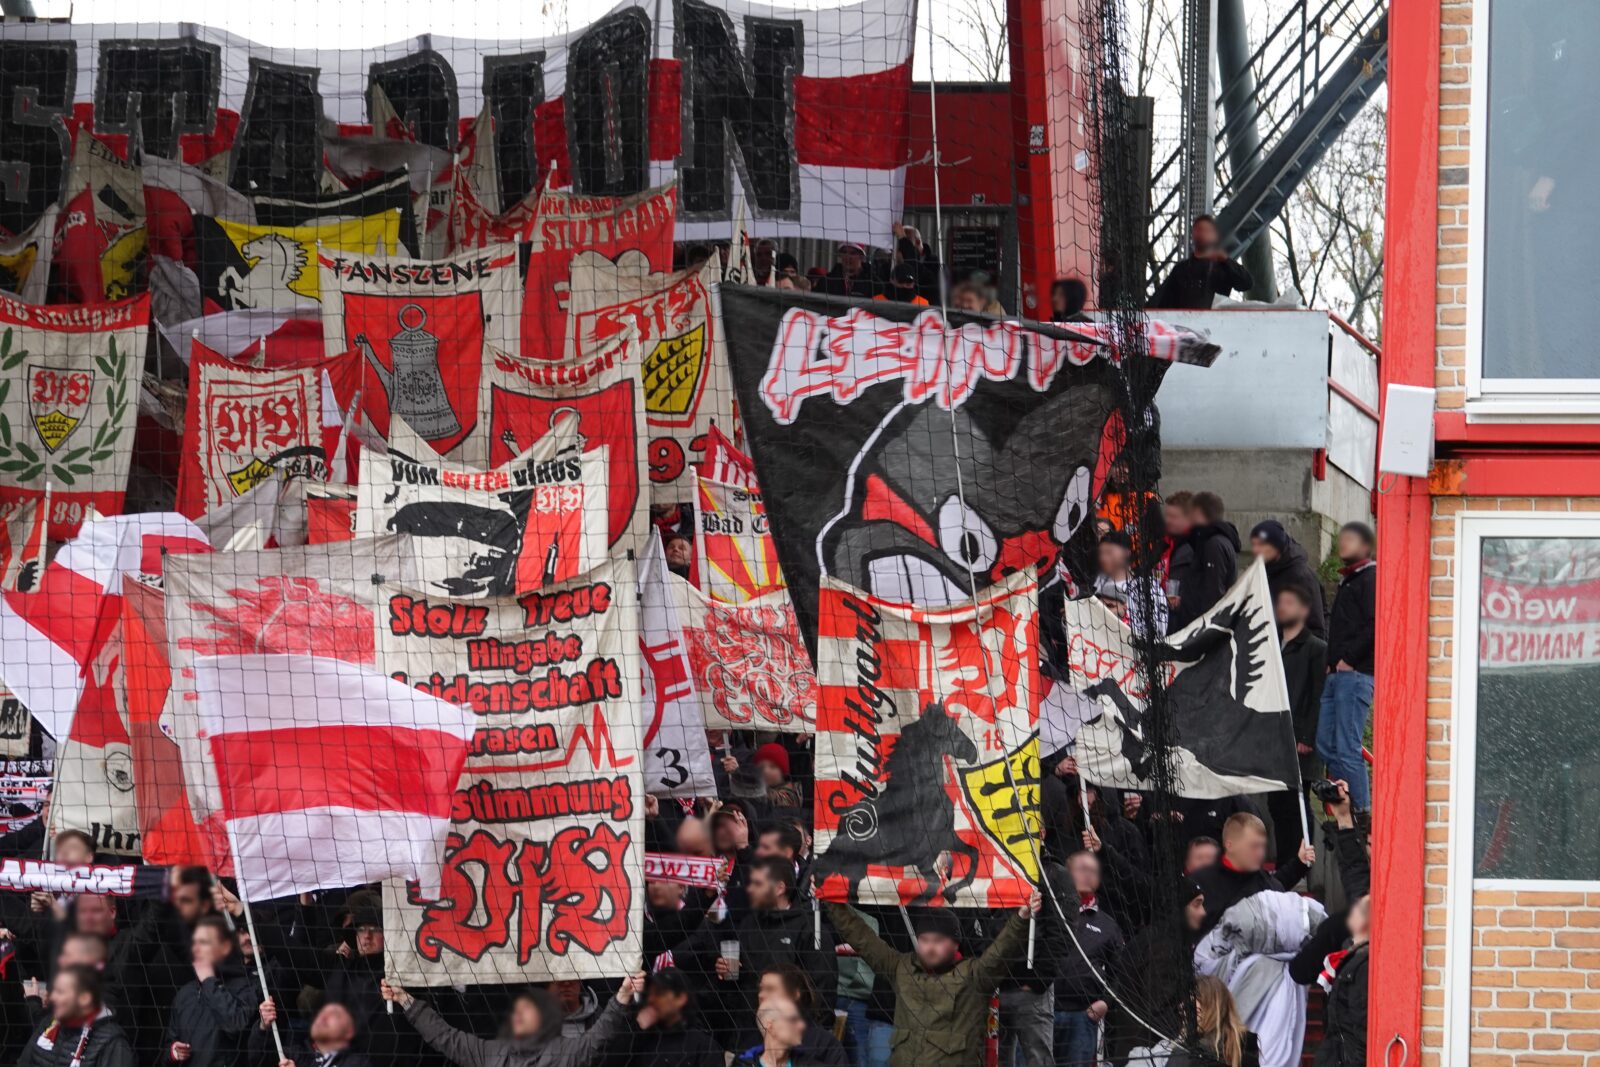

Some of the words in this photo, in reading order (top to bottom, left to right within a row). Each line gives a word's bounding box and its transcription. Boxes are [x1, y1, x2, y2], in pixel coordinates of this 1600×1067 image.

[541, 186, 677, 252] STUTTGART
[333, 255, 494, 287] FANSZENE
[31, 304, 133, 331] Stuttgart
[494, 342, 632, 387] Stuttgart
[214, 395, 299, 453] VfB
[391, 459, 440, 486] VOM
[701, 511, 744, 535] Bad
[389, 594, 490, 638] Stolz
[517, 582, 612, 629] Treue
[466, 630, 583, 675] Hingabe
[827, 597, 898, 817] Stuttgart
[467, 723, 560, 757] rasen
[982, 728, 1005, 752] 18
[655, 747, 689, 788] 3
[406, 821, 633, 967] VfB
